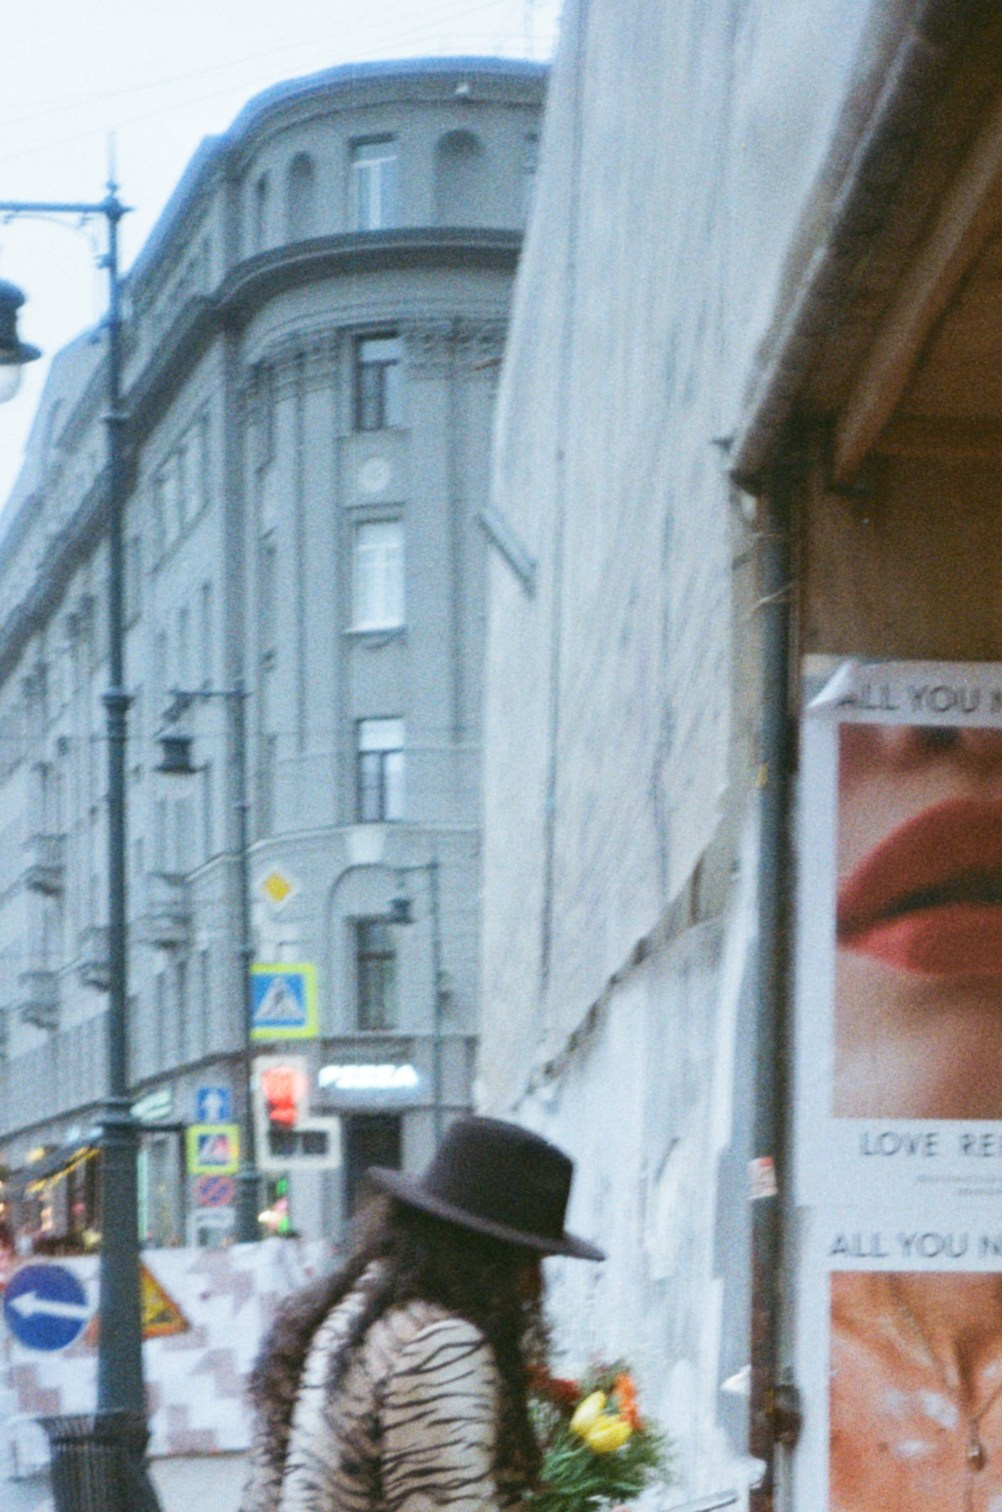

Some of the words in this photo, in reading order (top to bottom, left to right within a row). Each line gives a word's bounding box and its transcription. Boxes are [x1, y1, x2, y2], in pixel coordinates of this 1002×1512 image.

[907, 685, 982, 714] YOU
[859, 1131, 940, 1157] LOVE
[828, 1232, 889, 1257] ALL
[897, 1232, 968, 1258] YOU
